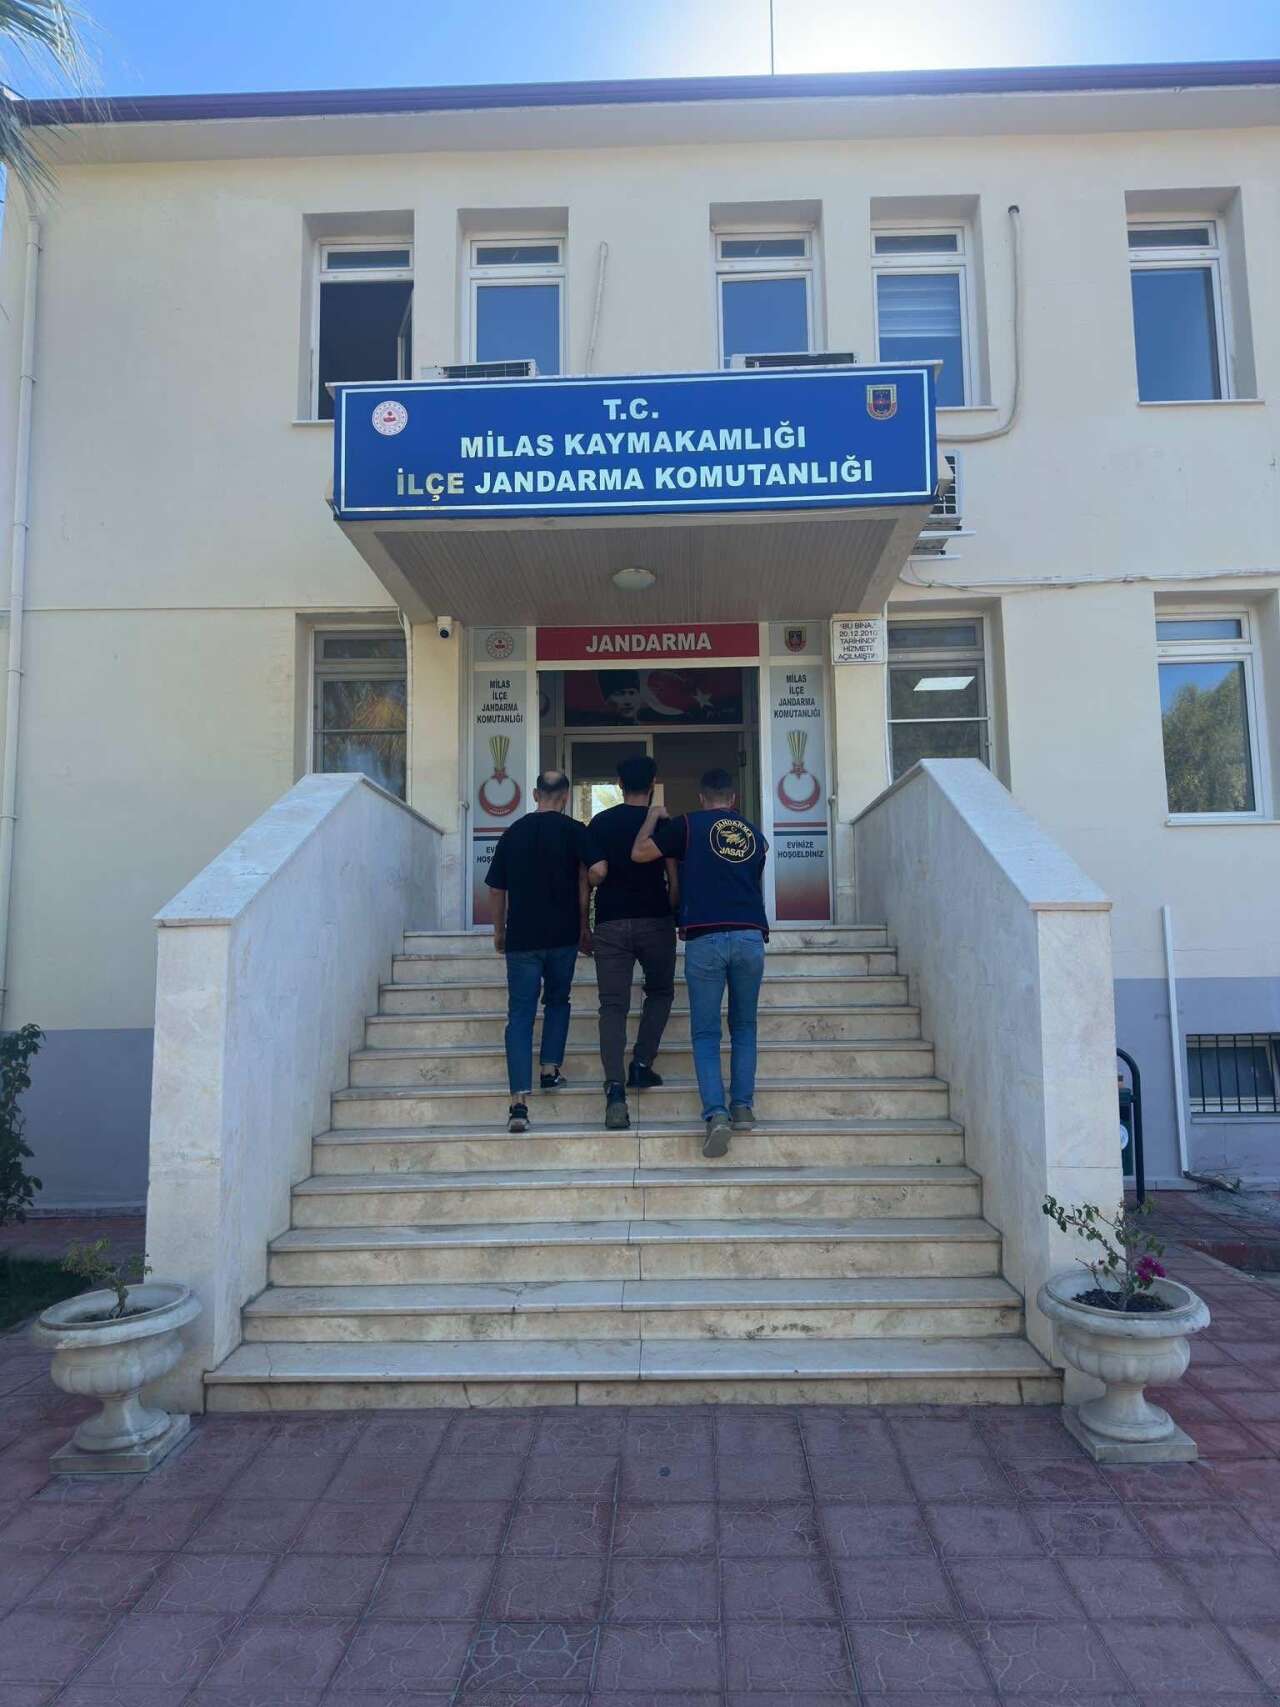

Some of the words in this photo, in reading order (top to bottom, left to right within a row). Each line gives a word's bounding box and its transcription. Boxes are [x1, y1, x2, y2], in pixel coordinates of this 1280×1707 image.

[603, 398, 660, 420] T.C.
[460, 430, 554, 458] MİLAS
[564, 420, 806, 456] KAYMAKAMLIĞI
[396, 467, 465, 502] İLÇE
[474, 468, 646, 494] JANDARMA
[655, 454, 873, 490] KOMUTANLIĞI
[585, 632, 713, 653] JANDARMA
[489, 679, 511, 689] MİLAS
[786, 674, 807, 683] MİLAS
[492, 690, 508, 702] İLÇE
[789, 685, 804, 696] İLÇE
[481, 703, 518, 712] JANDARMA
[778, 698, 816, 707] JANDARMA
[477, 713, 524, 724] KOMUTANLIĞI
[774, 707, 821, 719] KOMUTANLIĞI
[715, 819, 753, 838] JANDARMA
[786, 840, 815, 849] EVİNİZE
[719, 846, 746, 858] JASAT
